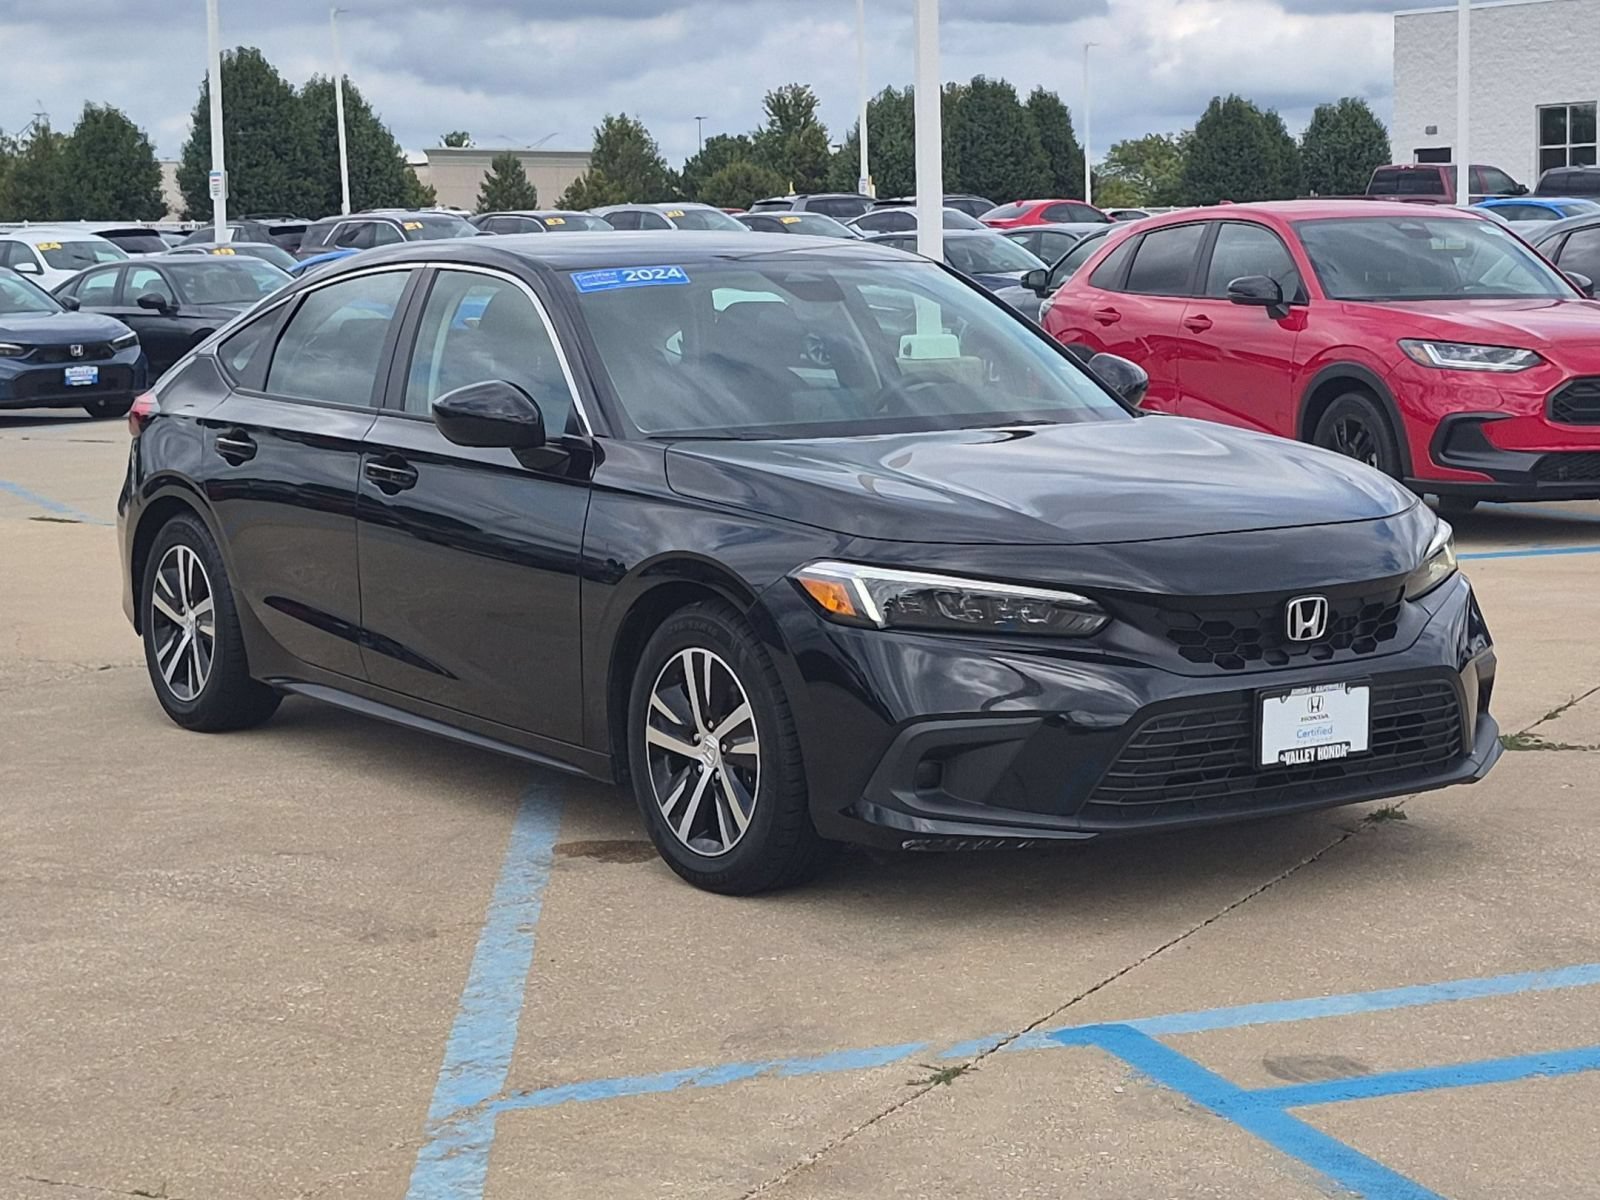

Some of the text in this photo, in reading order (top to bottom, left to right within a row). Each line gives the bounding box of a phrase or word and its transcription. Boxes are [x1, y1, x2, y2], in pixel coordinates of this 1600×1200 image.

[622, 267, 683, 282] 2024
[1300, 713, 1329, 722] HONDA
[1297, 724, 1333, 738] Certified
[1317, 743, 1347, 760] HONDA
